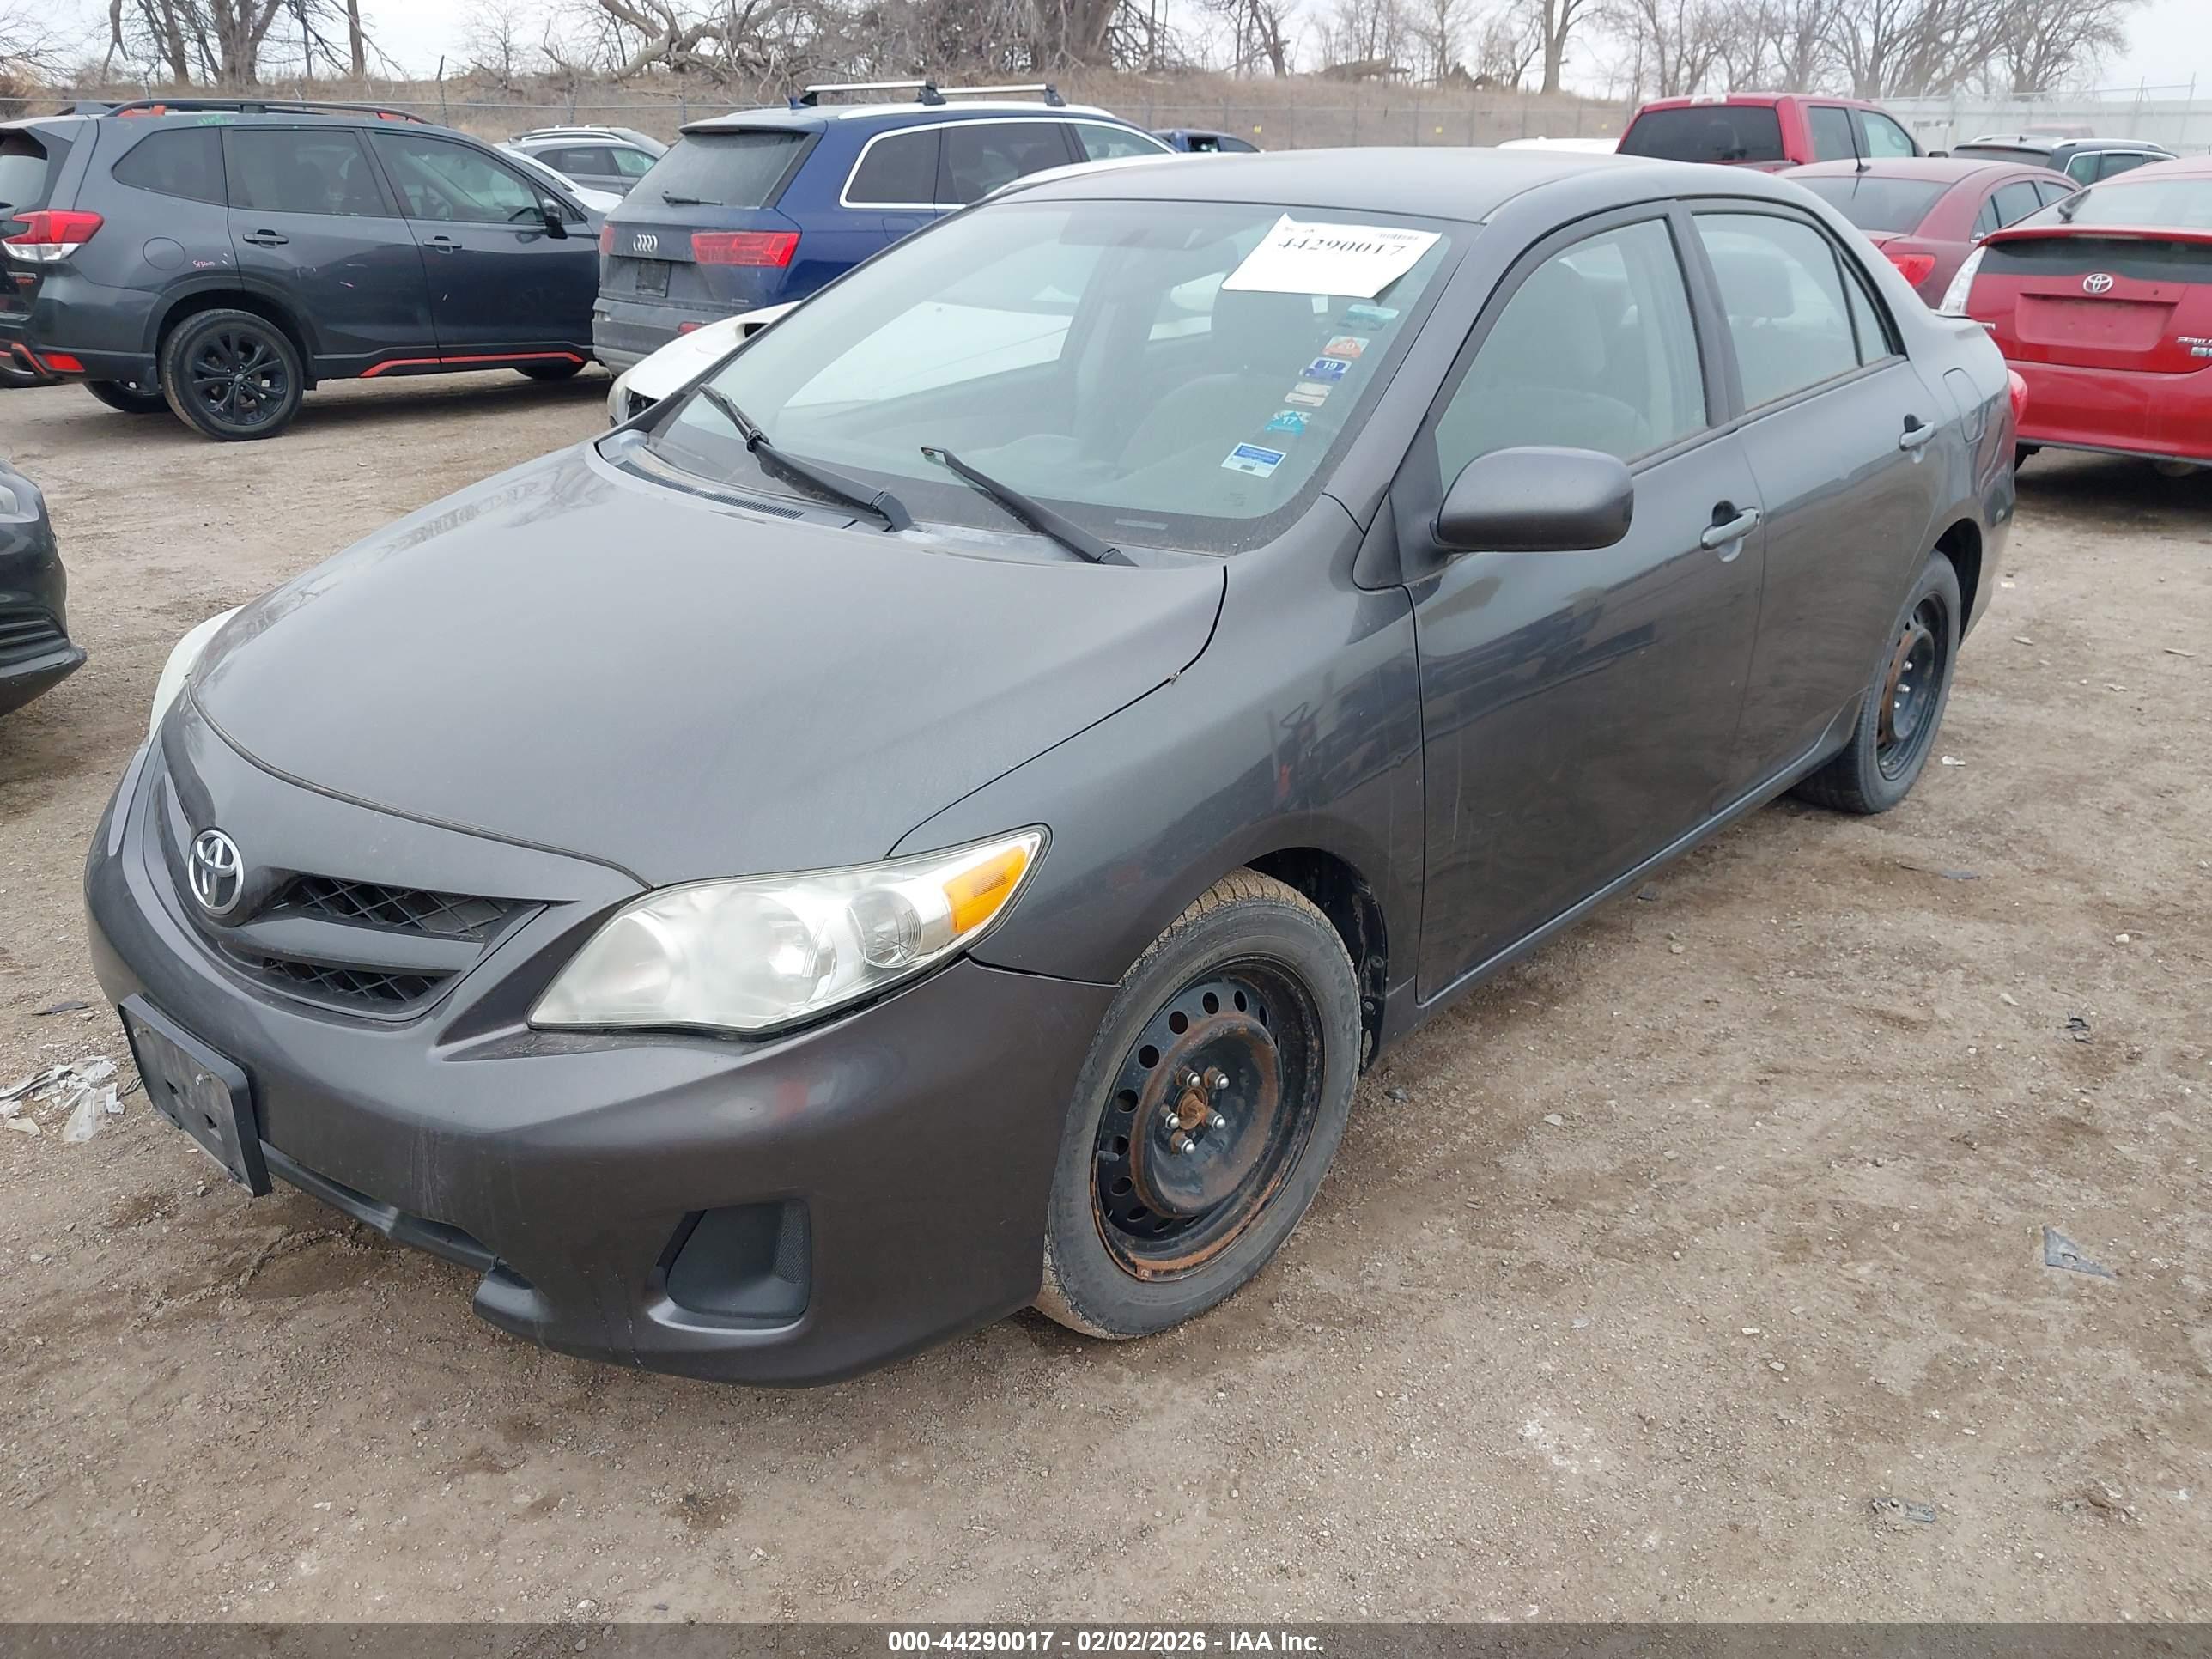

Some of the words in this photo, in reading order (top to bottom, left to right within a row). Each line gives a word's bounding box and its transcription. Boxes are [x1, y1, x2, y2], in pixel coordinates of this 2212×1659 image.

[1277, 237, 1407, 256] 44290017
[1323, 361, 1339, 370] 19
[1282, 416, 1298, 425] 17
